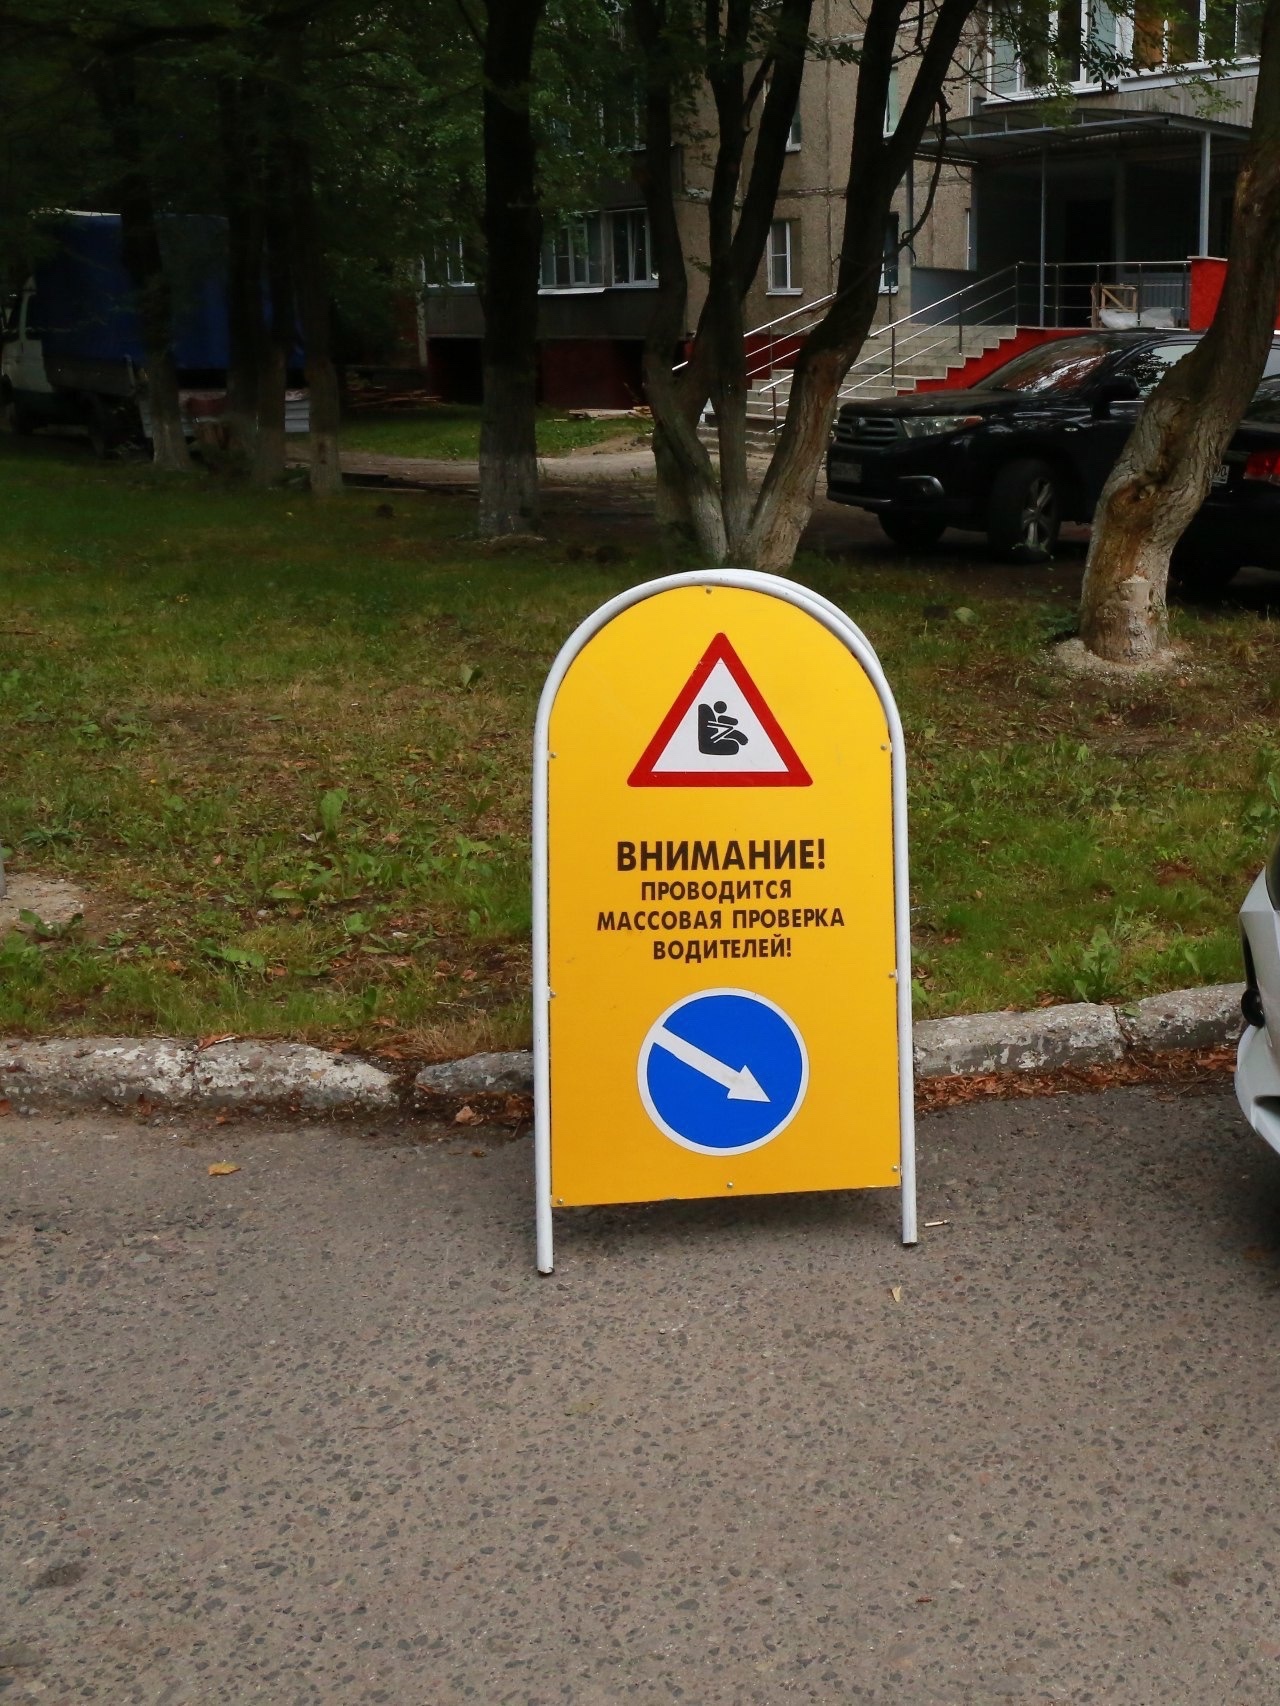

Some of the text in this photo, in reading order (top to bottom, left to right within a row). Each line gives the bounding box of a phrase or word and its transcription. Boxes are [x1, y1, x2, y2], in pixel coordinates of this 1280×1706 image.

[616, 838, 826, 872] ВНИМАНИЕ!
[640, 879, 792, 904] ПРОВОДИТСЯ
[596, 907, 846, 932] МАССОВАЯ ПРОВЕРКА
[652, 933, 792, 963] ВОДИТЕЛЕЙ!
